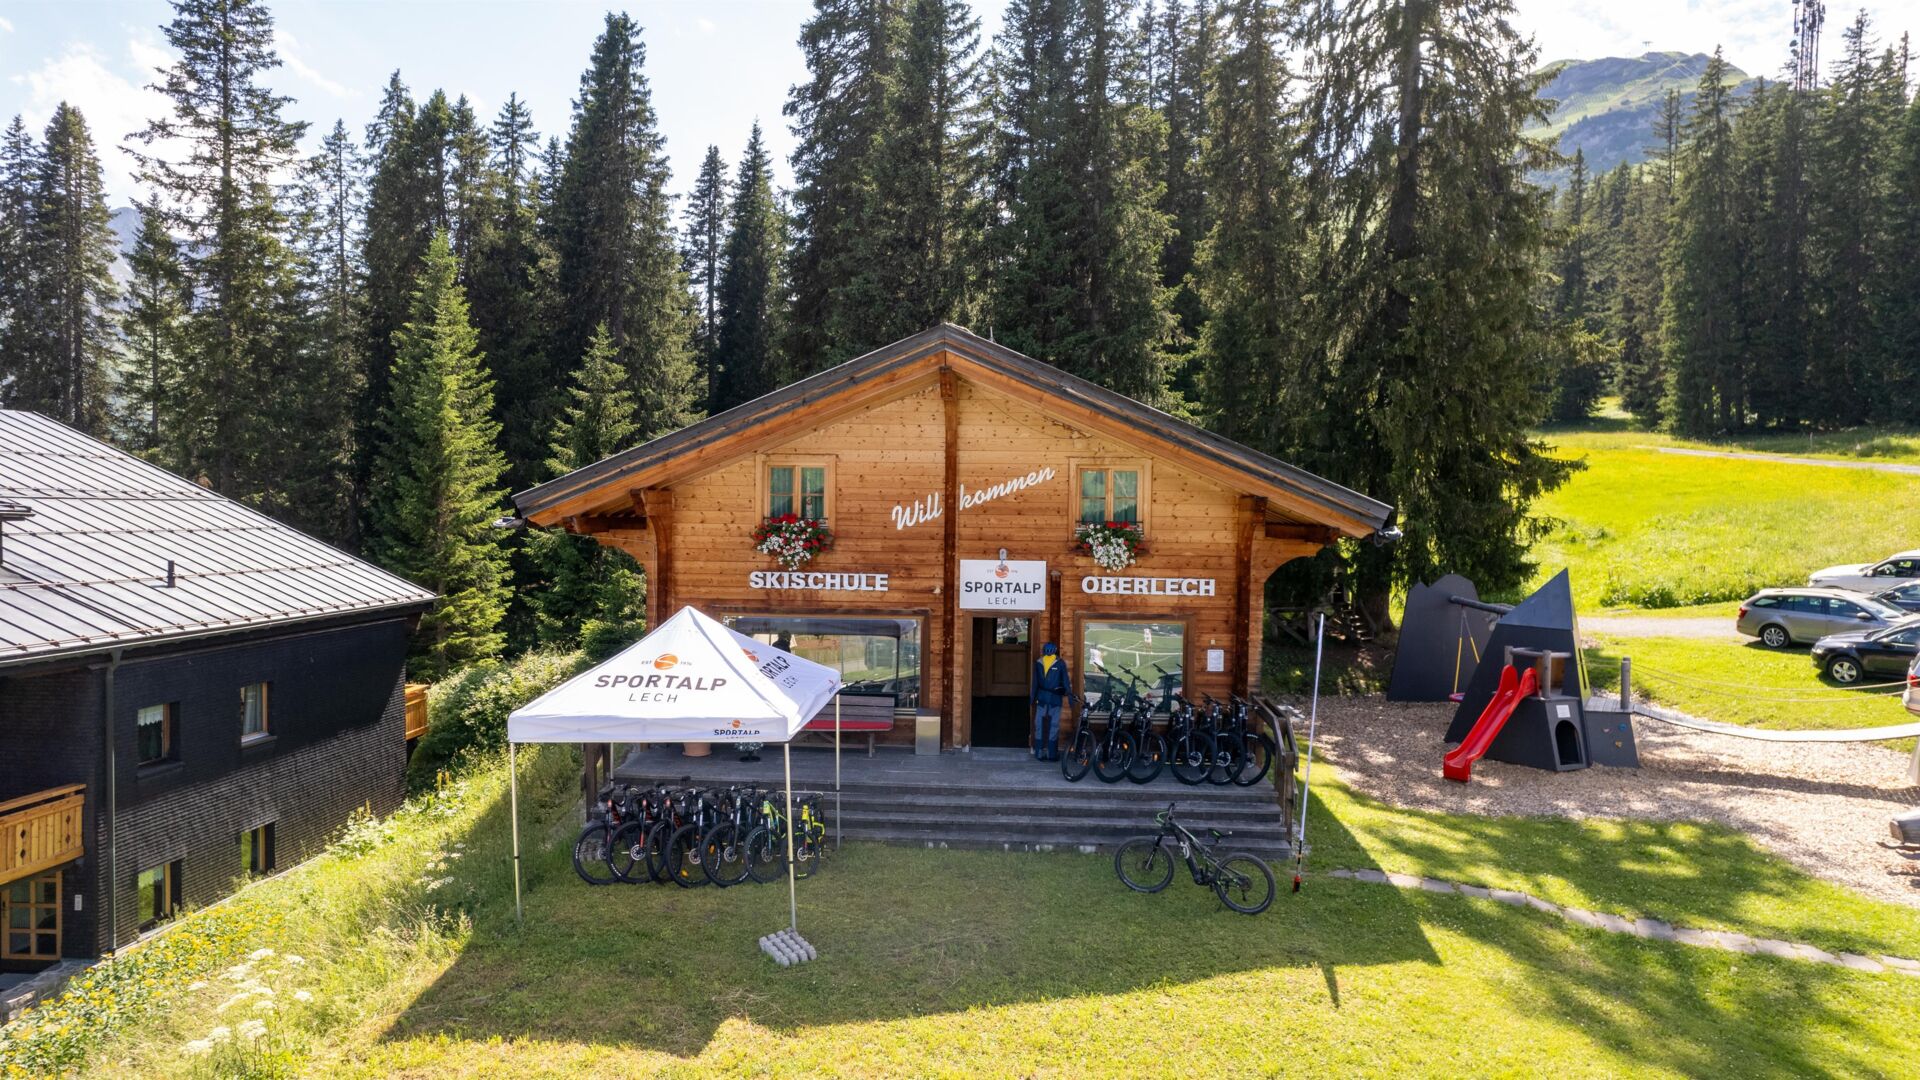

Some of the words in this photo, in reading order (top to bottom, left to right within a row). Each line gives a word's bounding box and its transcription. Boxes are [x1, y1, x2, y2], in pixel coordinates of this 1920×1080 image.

[749, 571, 888, 592] SKISCHULE
[1081, 577, 1215, 597] OBERLECH
[964, 581, 1042, 594] SPORTALP
[987, 597, 1017, 605] LECH
[758, 656, 792, 681] ORTALP
[595, 674, 727, 692] SPORTALP
[628, 692, 679, 703] LECH
